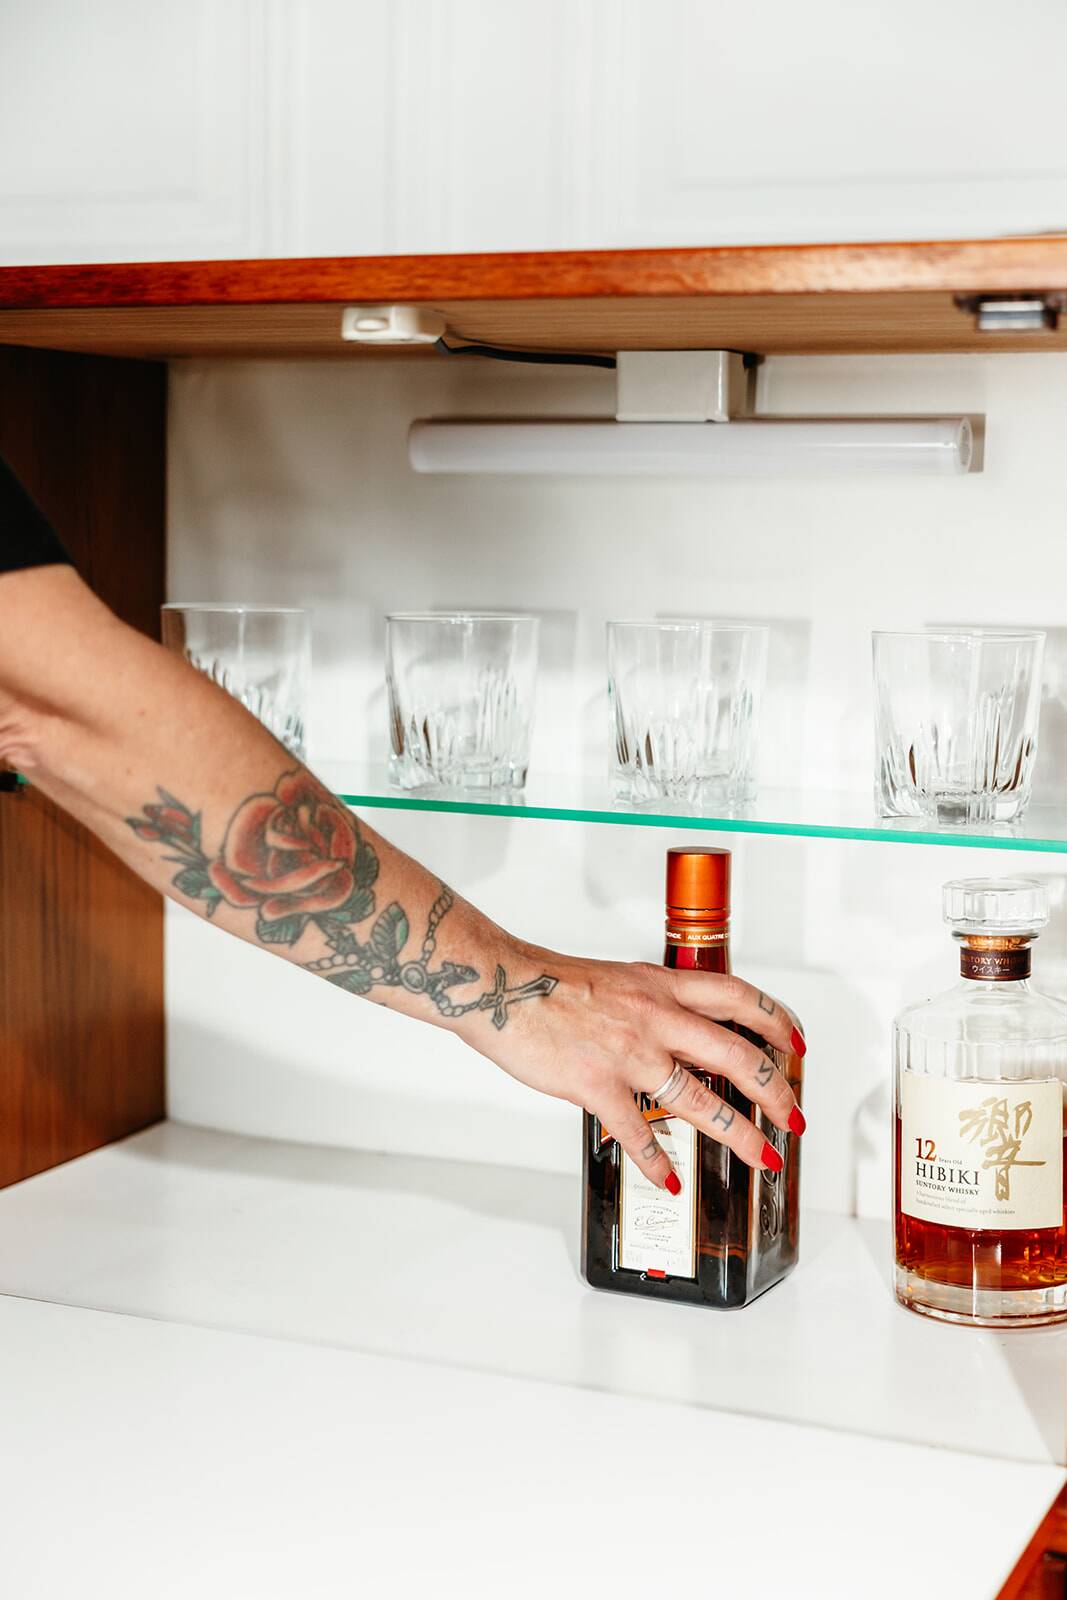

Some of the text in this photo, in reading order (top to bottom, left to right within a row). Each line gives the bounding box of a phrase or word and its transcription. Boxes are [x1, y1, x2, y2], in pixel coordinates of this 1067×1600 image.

[972, 965, 1010, 975] ウイスキー
[915, 1137, 937, 1162] 12
[916, 1161, 980, 1186] HIBIKI
[915, 1180, 946, 1192] SUNTORY
[947, 1186, 980, 1196] WHISKY
